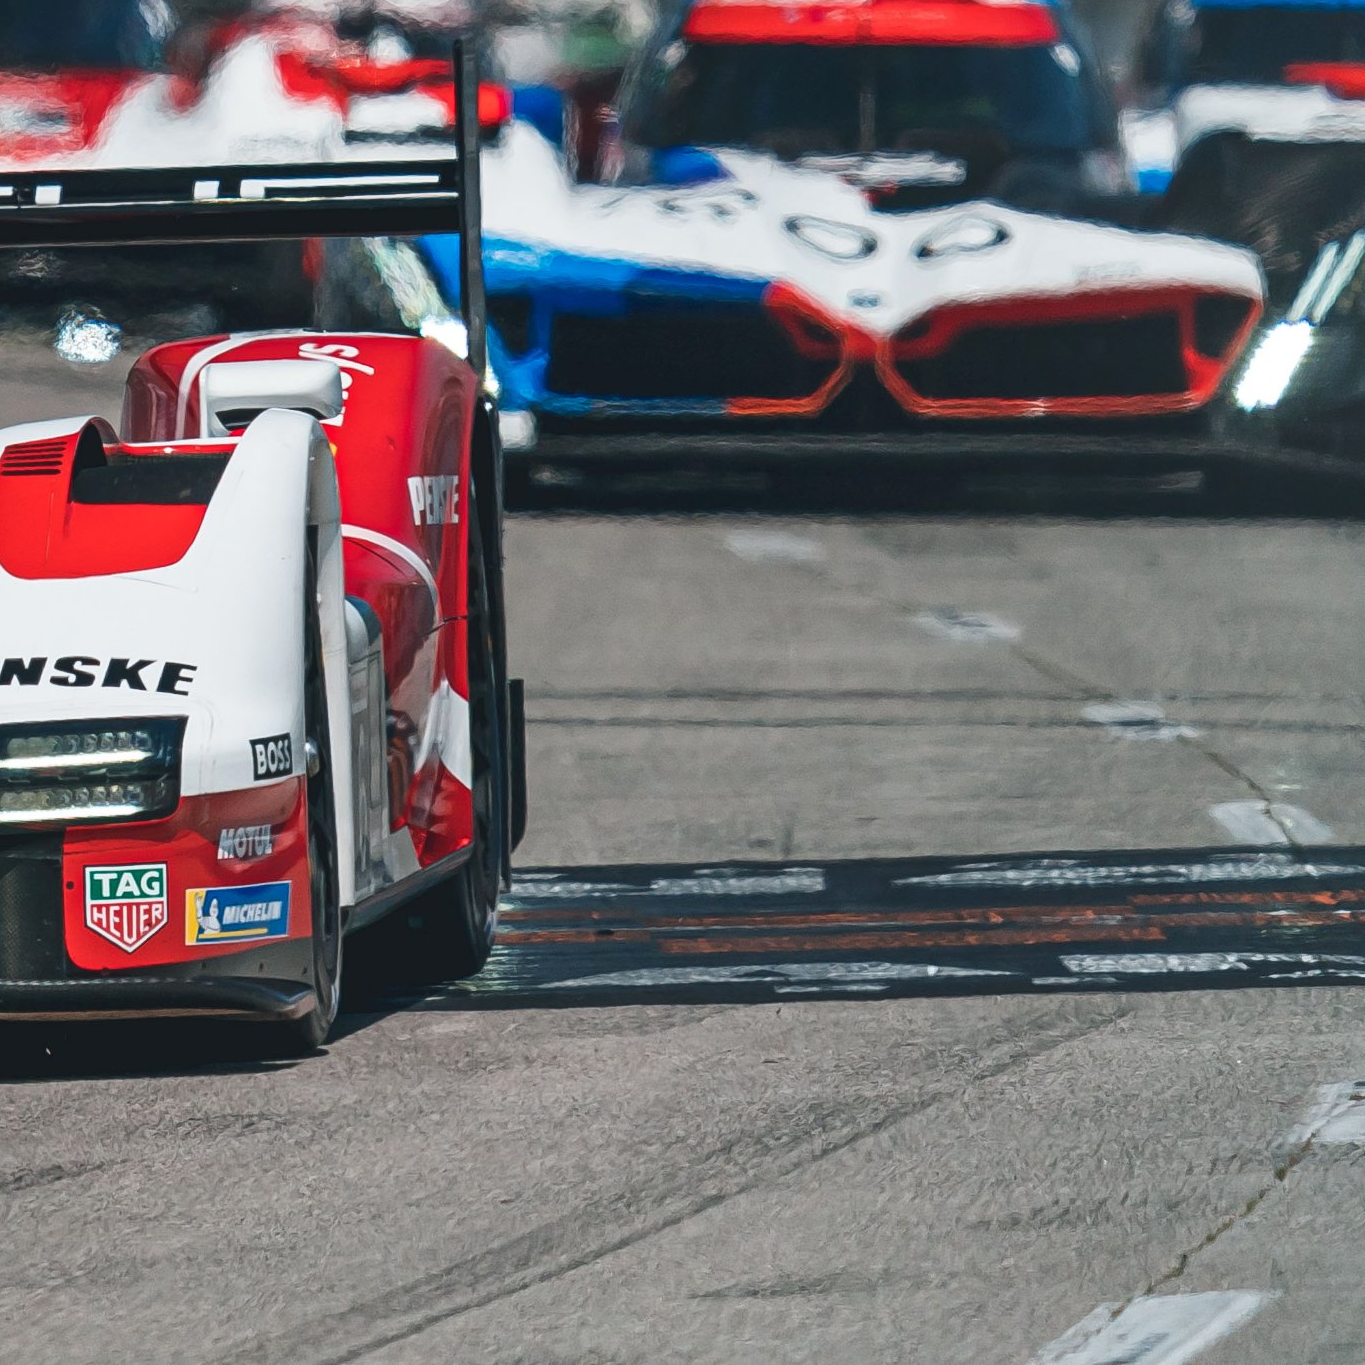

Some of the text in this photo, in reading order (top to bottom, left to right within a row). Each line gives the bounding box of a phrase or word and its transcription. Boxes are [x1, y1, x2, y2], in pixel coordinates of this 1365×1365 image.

[254, 738, 291, 776] BOSS
[217, 824, 273, 860] MOTUL
[93, 870, 161, 898] TAG
[92, 902, 163, 946] HEUER
[221, 900, 283, 925] MICHELIN
